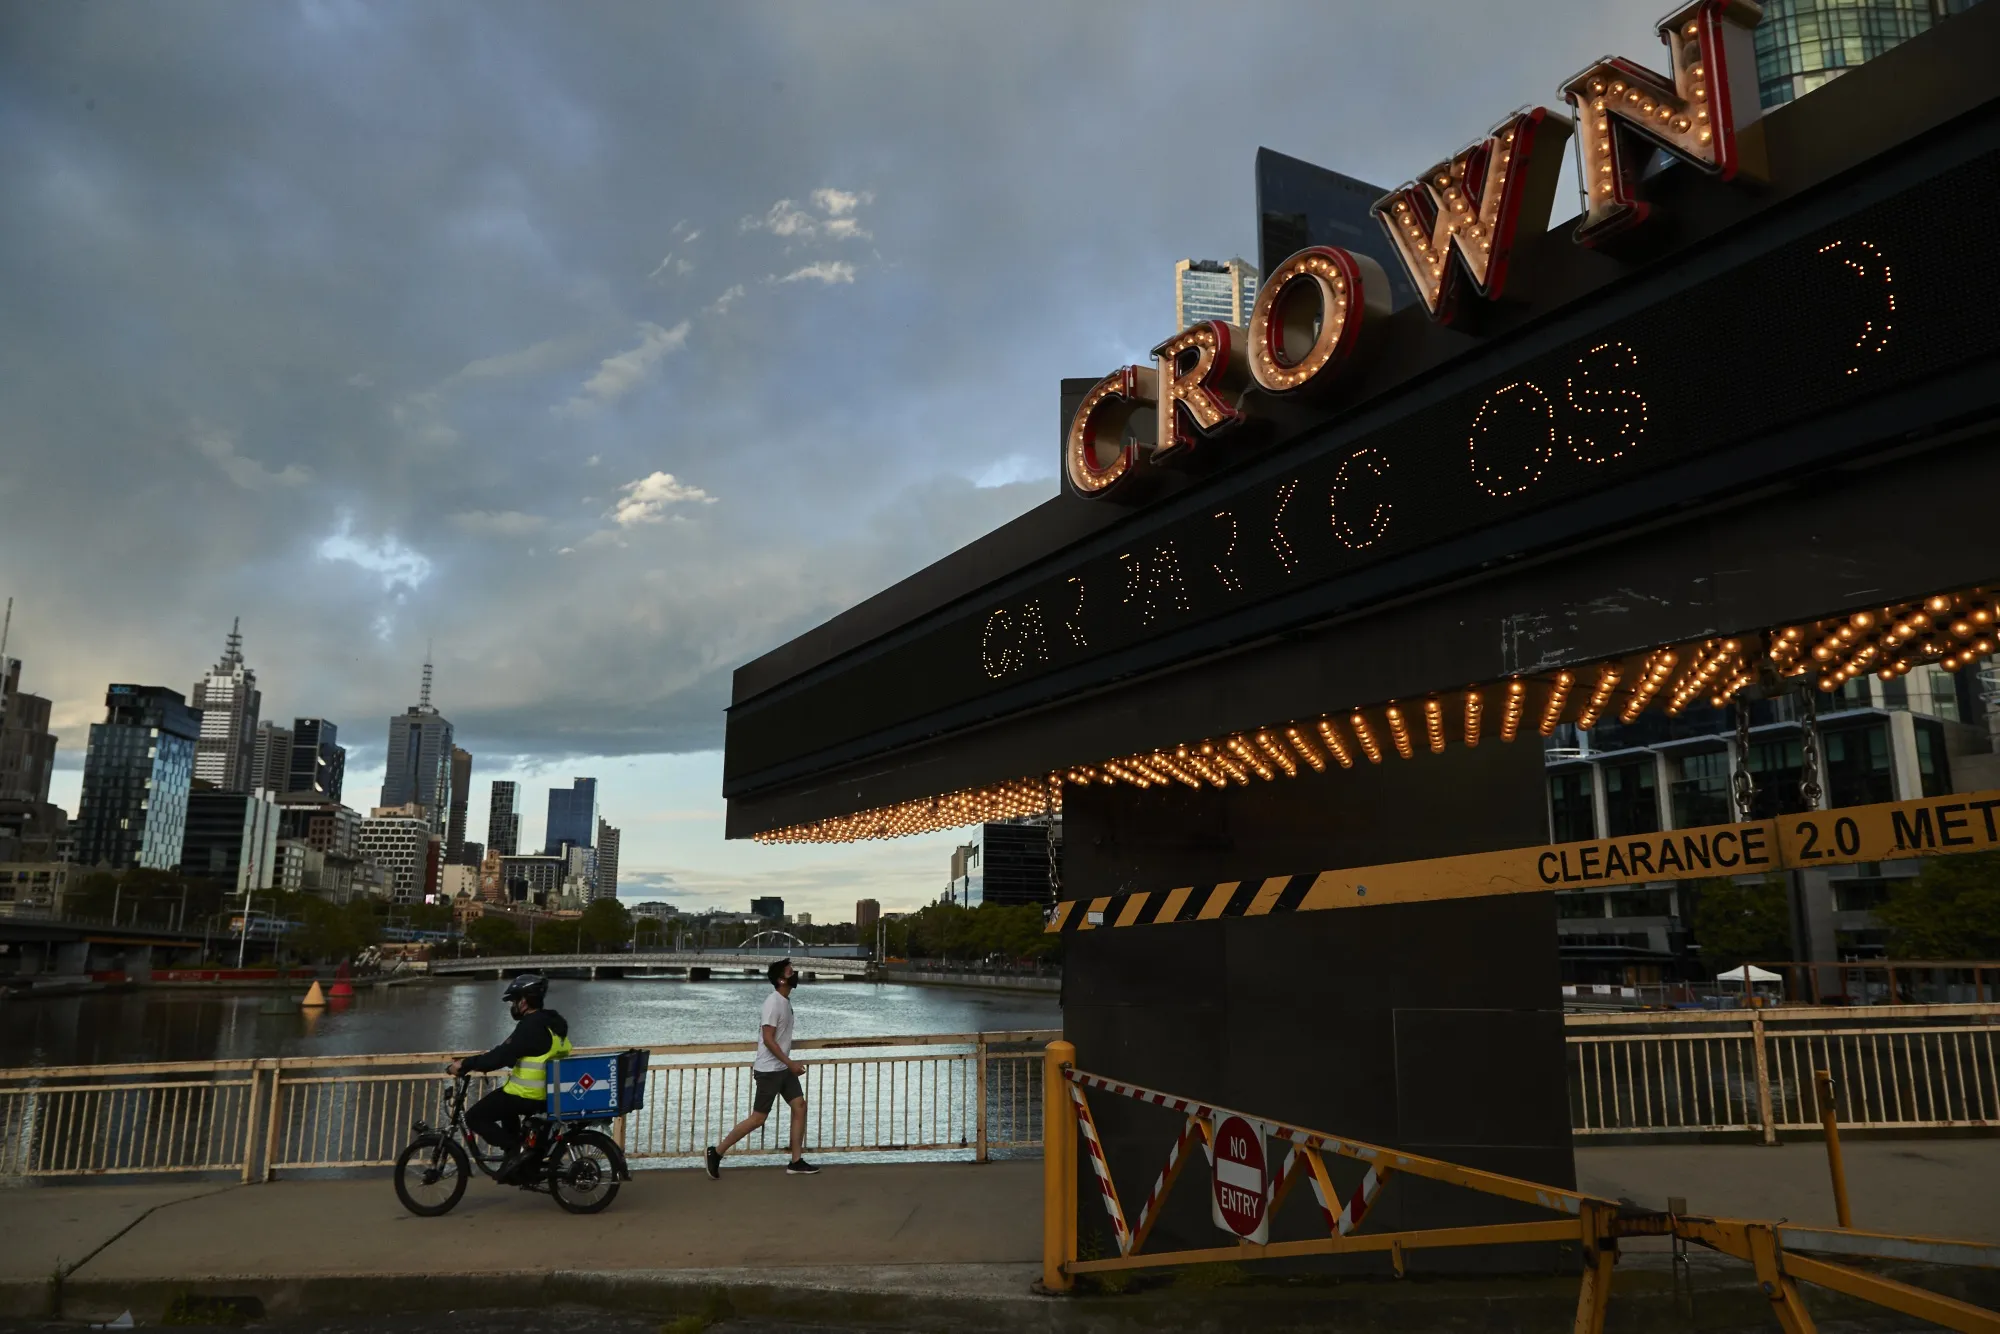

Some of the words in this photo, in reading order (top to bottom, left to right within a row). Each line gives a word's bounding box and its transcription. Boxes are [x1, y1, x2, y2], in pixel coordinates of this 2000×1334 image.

[1066, 0, 1742, 499] CROWN
[1537, 827, 1769, 884] CLEARANCE
[1796, 816, 1861, 860] 2.0
[1891, 799, 2000, 850] MET
[607, 1058, 618, 1107] Domino's
[1230, 1136, 1247, 1160] NO
[1221, 1186, 1258, 1219] ENTRY
